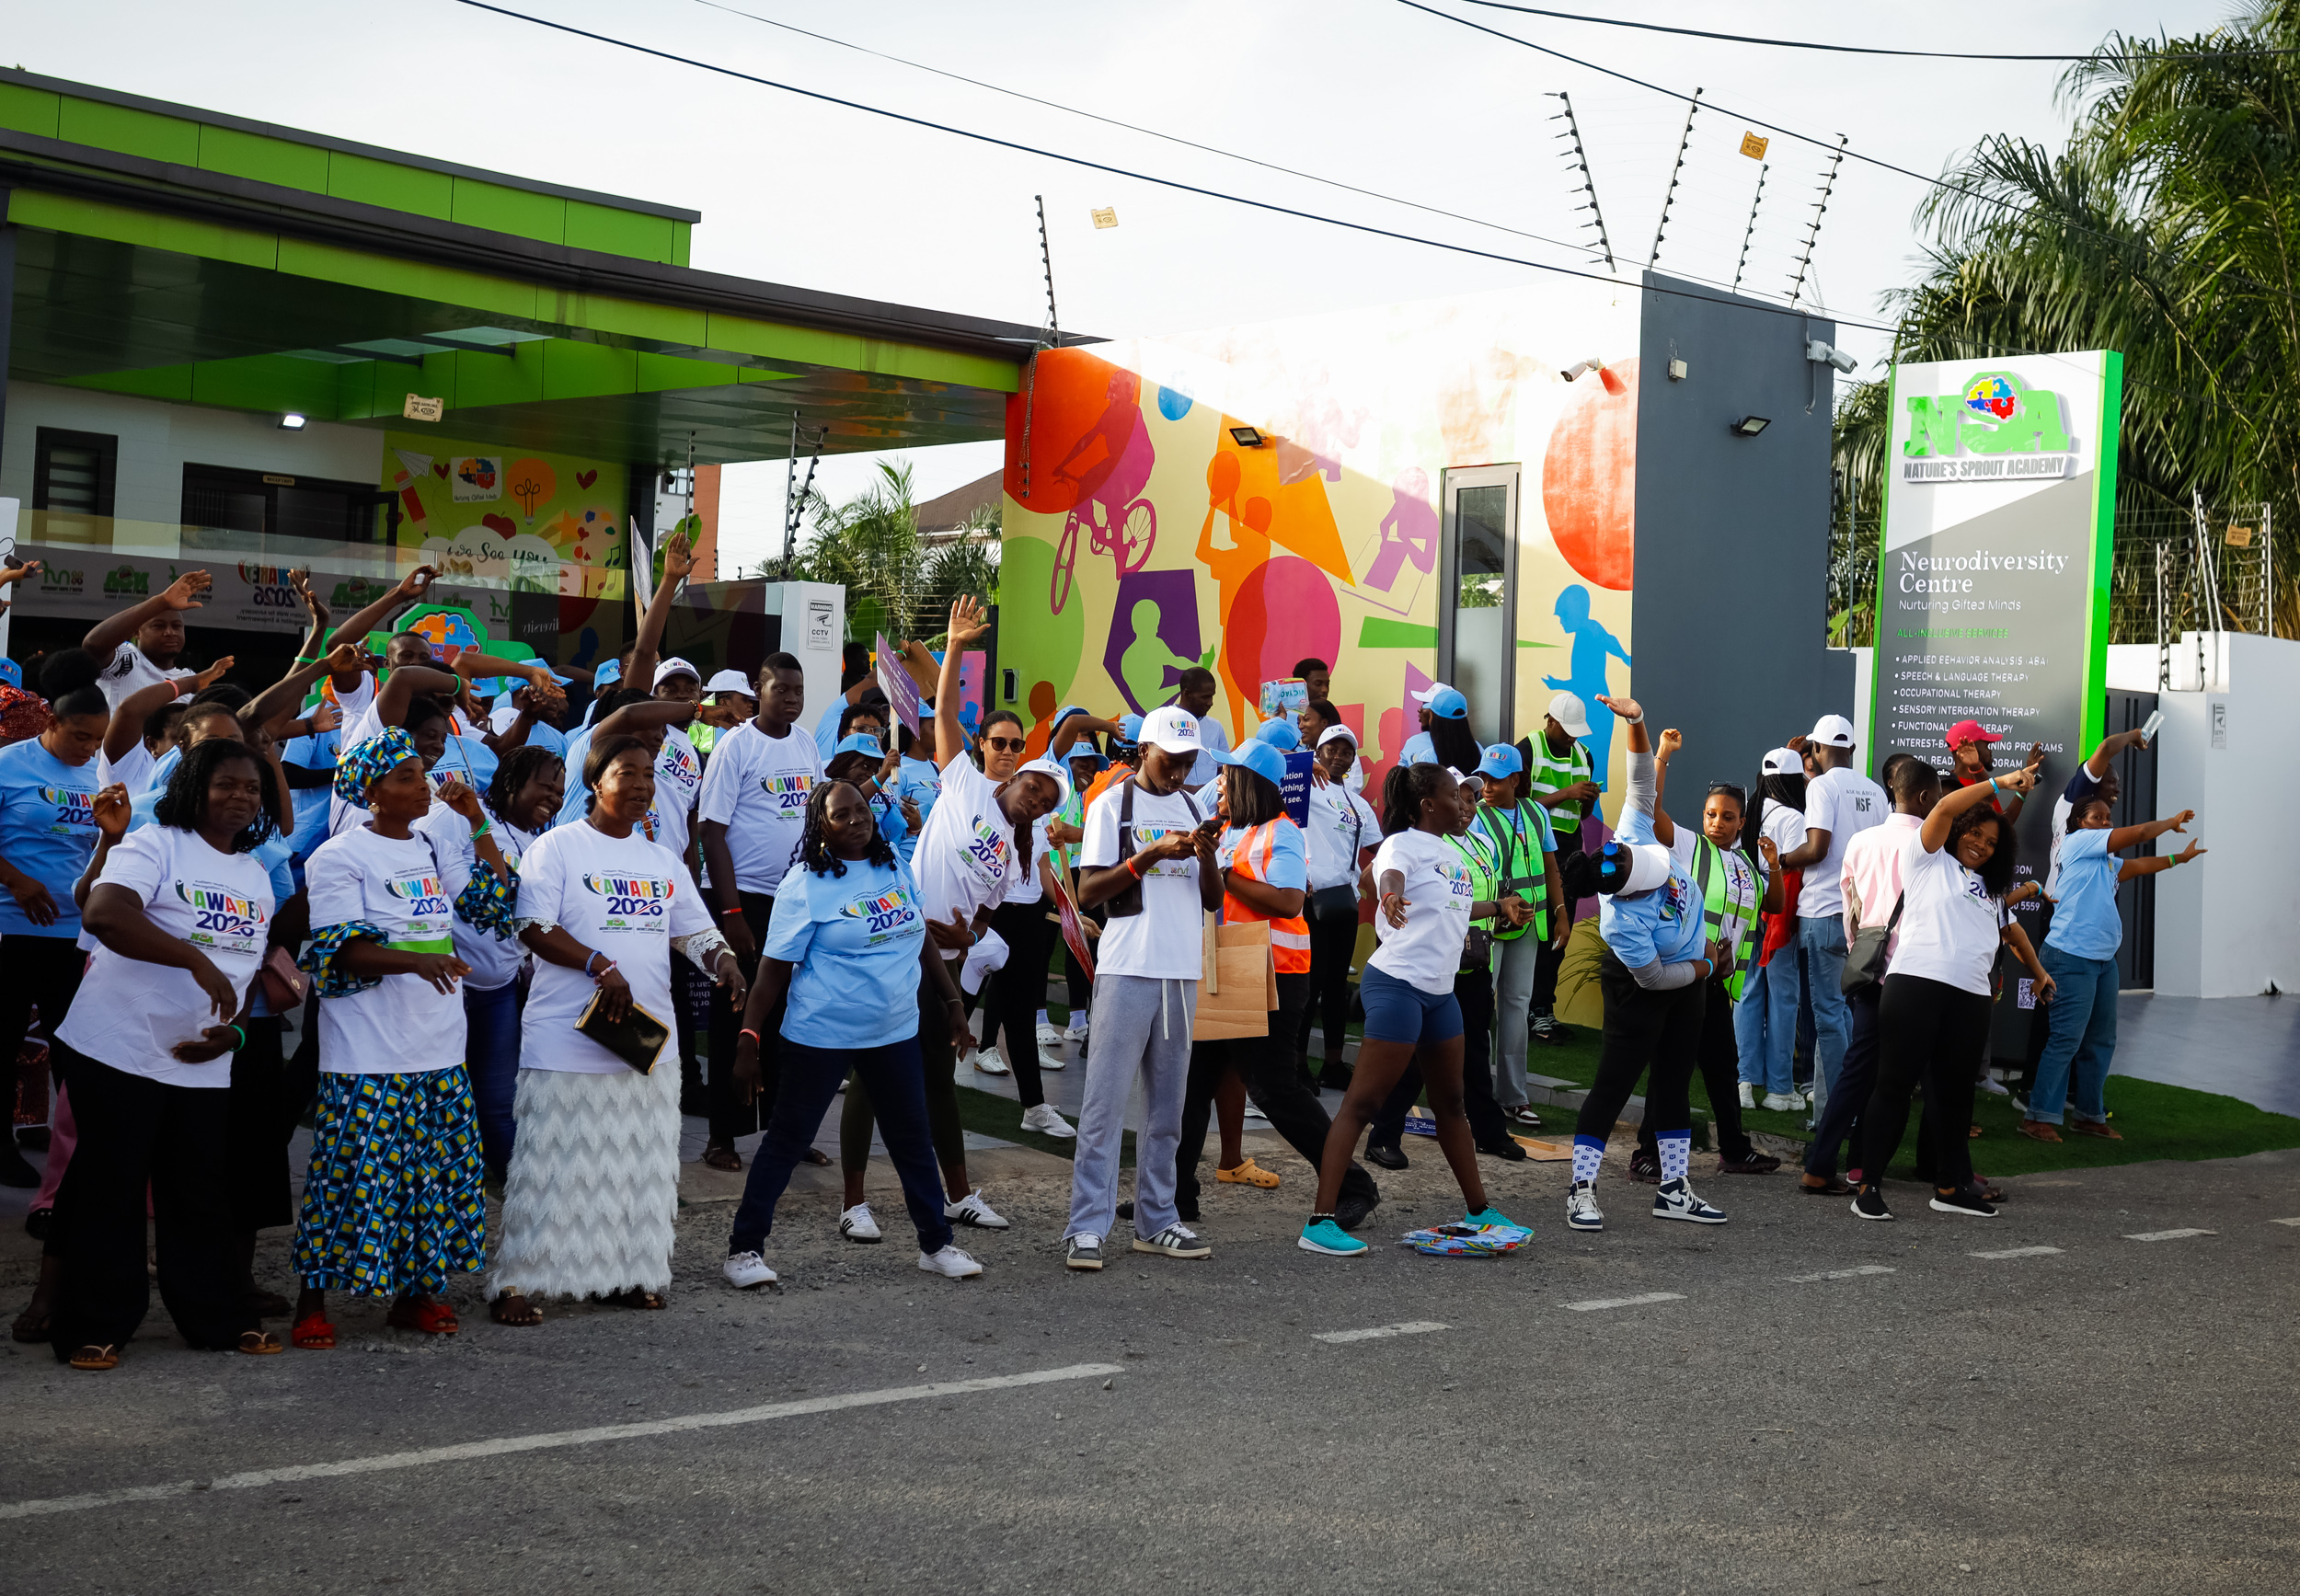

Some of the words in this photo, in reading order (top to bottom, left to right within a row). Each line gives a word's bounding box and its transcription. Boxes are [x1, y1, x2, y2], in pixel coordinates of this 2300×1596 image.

[1903, 371, 2070, 456] NSA
[1903, 461, 1957, 478] NATURE'S
[1960, 460, 2005, 477] SPROUT
[2007, 457, 2064, 475] ACADEMY
[1900, 549, 2069, 575] Neurodiversity
[1899, 572, 1973, 593] Centre
[810, 603, 833, 612] WARNING
[1899, 600, 1949, 614] Nurturing
[1951, 600, 1984, 611] Gifted
[1988, 599, 2021, 611] Minds
[1897, 628, 1963, 638] ALL-INCLUSIVE
[1966, 628, 2009, 638] SERVICES
[1902, 655, 1937, 664] APPLIED
[1938, 655, 1980, 665] BEHAVIOR
[1983, 656, 2023, 666] ANALYSIS
[1901, 672, 1932, 681] SPEECH
[1935, 672, 1940, 681] &
[1943, 672, 1988, 682] LANGUAGE
[1991, 672, 2030, 683] THERAPY
[1900, 688, 1961, 698] OCCUPATIONAL
[1963, 689, 2001, 699] THERAPY
[1899, 705, 1937, 715] SENSORY
[1938, 706, 1998, 716] INTERGRATION
[2001, 706, 2041, 717] THERAPY
[1178, 729, 1194, 737] 2026
[1898, 721, 1949, 731] FUNCTIONAL
[1980, 724, 2013, 733] HERAPY
[1897, 739, 1948, 748] INTEREST-BA
[2015, 742, 2064, 752] PRORAMS
[1992, 758, 2023, 768] OGRAM
[431, 770, 470, 787] WARE
[663, 758, 696, 787] 2026
[1283, 772, 1304, 781] ntion
[1280, 783, 1305, 795] ything.
[57, 789, 98, 809] AWA
[778, 792, 809, 809] 202
[1856, 797, 1871, 811] NSF
[55, 807, 98, 828] 202
[969, 838, 1005, 878] 2026
[2015, 865, 2032, 875] GON
[400, 877, 441, 898] AWAR
[604, 878, 661, 898] AWARE
[1450, 880, 1473, 897] 2026
[1969, 881, 1988, 899] 20
[194, 890, 256, 920] AWARE
[410, 897, 448, 916] 2026
[606, 896, 663, 916] 2026
[2020, 901, 2041, 912] 5559
[196, 911, 255, 937] 2026
[866, 906, 914, 934] 2026
